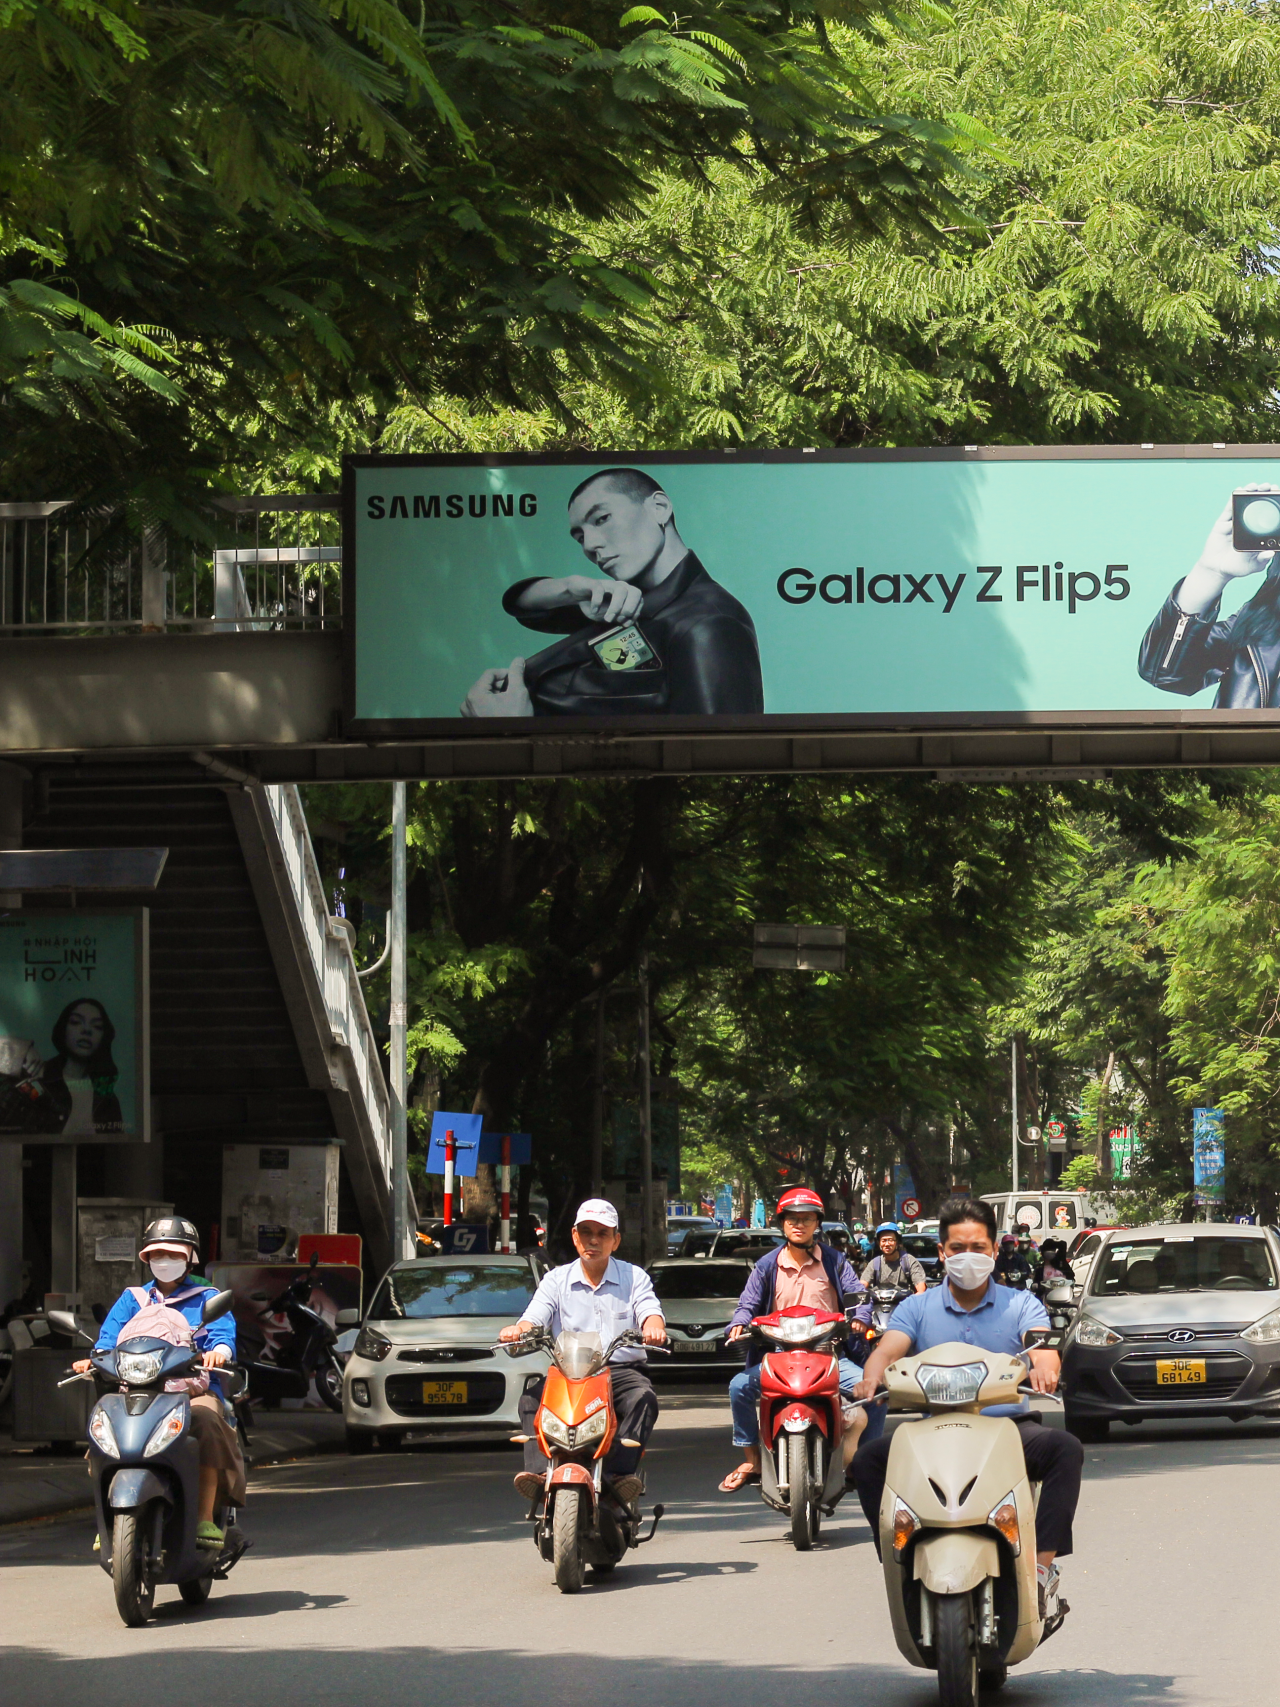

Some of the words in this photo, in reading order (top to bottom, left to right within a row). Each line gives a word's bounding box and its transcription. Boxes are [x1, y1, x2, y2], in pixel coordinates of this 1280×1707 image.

[367, 493, 538, 520] SAMSUNG
[776, 566, 967, 613] Galaxy
[975, 565, 1003, 603] Z
[1016, 561, 1131, 614] Flip5
[619, 631, 636, 645] 12:45
[24, 949, 97, 965] LINH
[1170, 1360, 1192, 1371] 30E
[1161, 1371, 1201, 1383] 681.49
[435, 1382, 454, 1393] 30F
